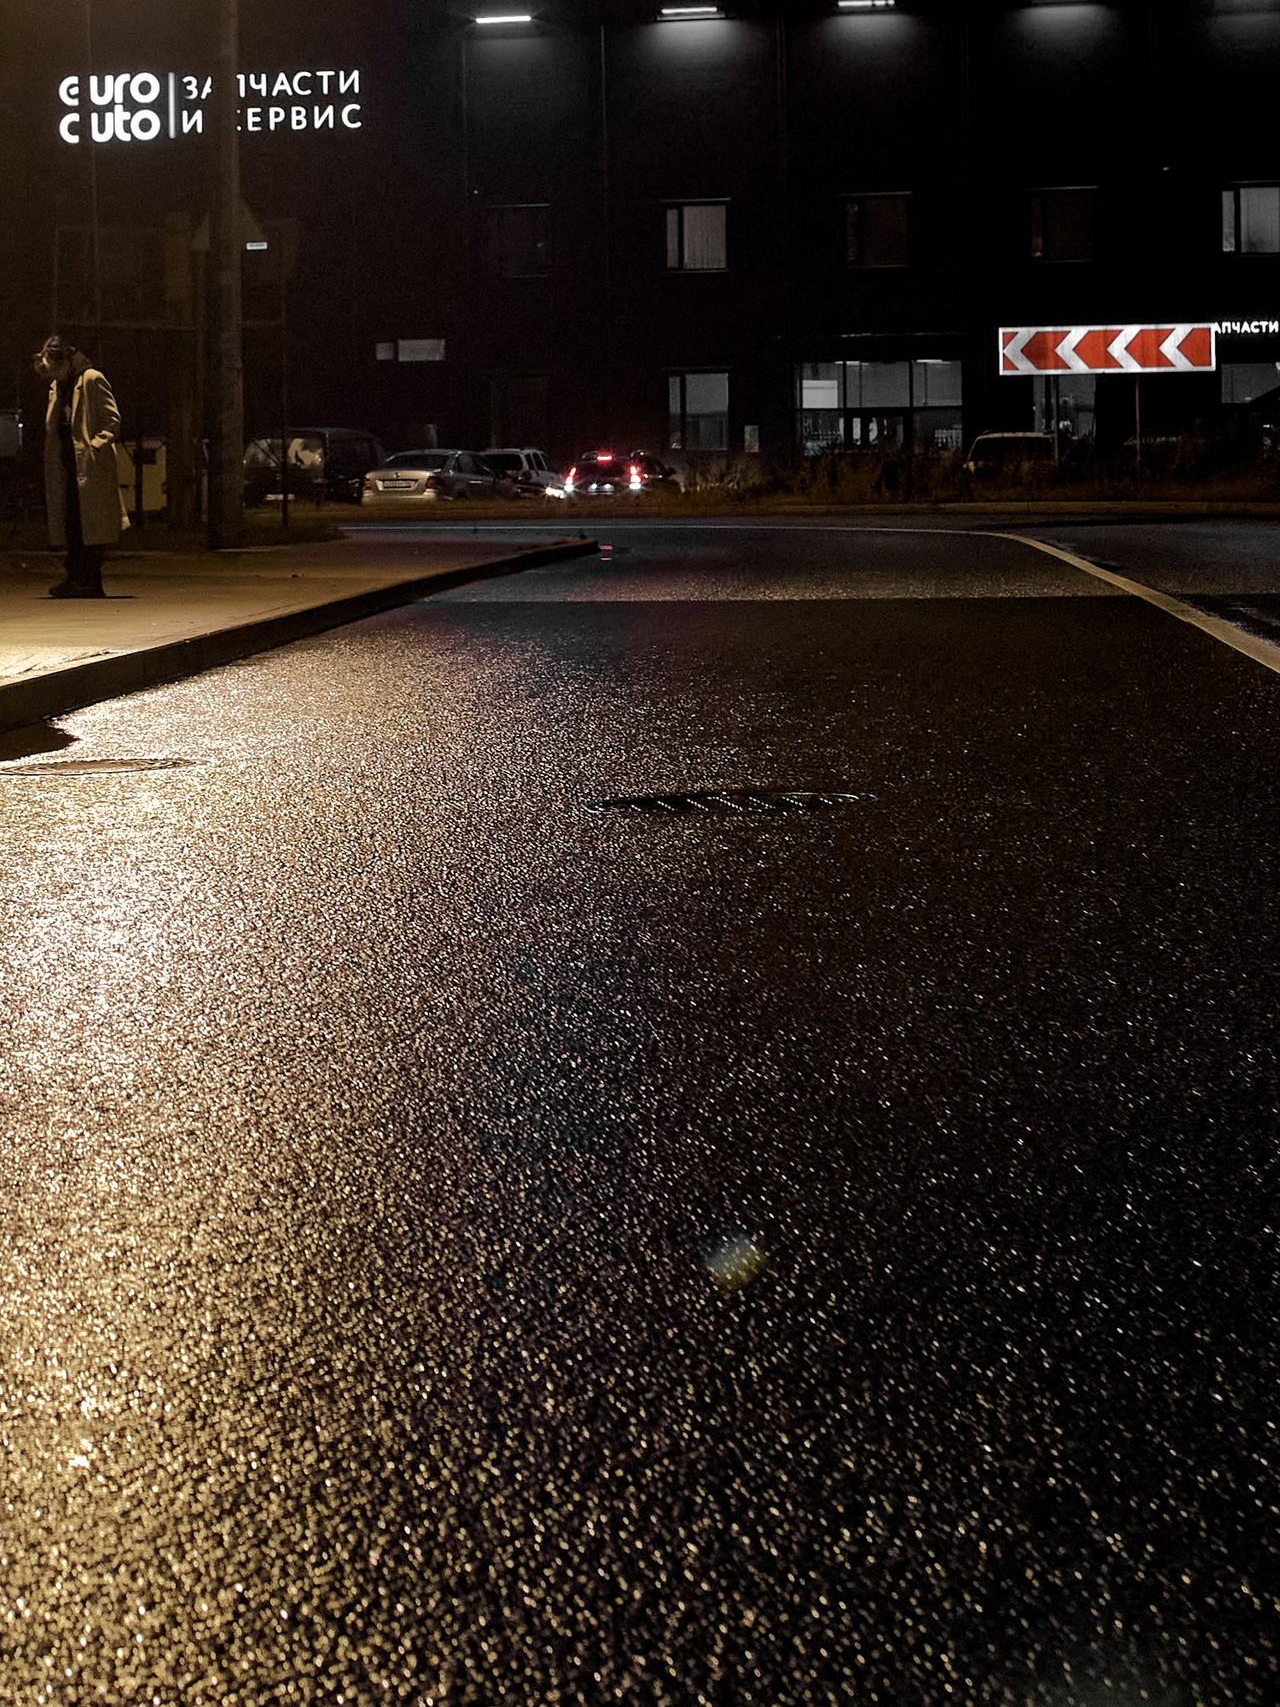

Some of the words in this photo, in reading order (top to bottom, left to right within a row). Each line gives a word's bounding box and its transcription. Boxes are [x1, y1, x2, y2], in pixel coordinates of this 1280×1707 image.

[58, 72, 161, 107] euro
[181, 109, 203, 134] И
[236, 103, 363, 132] ЕРВИС
[1214, 320, 1279, 334] АПЧАСТИ
